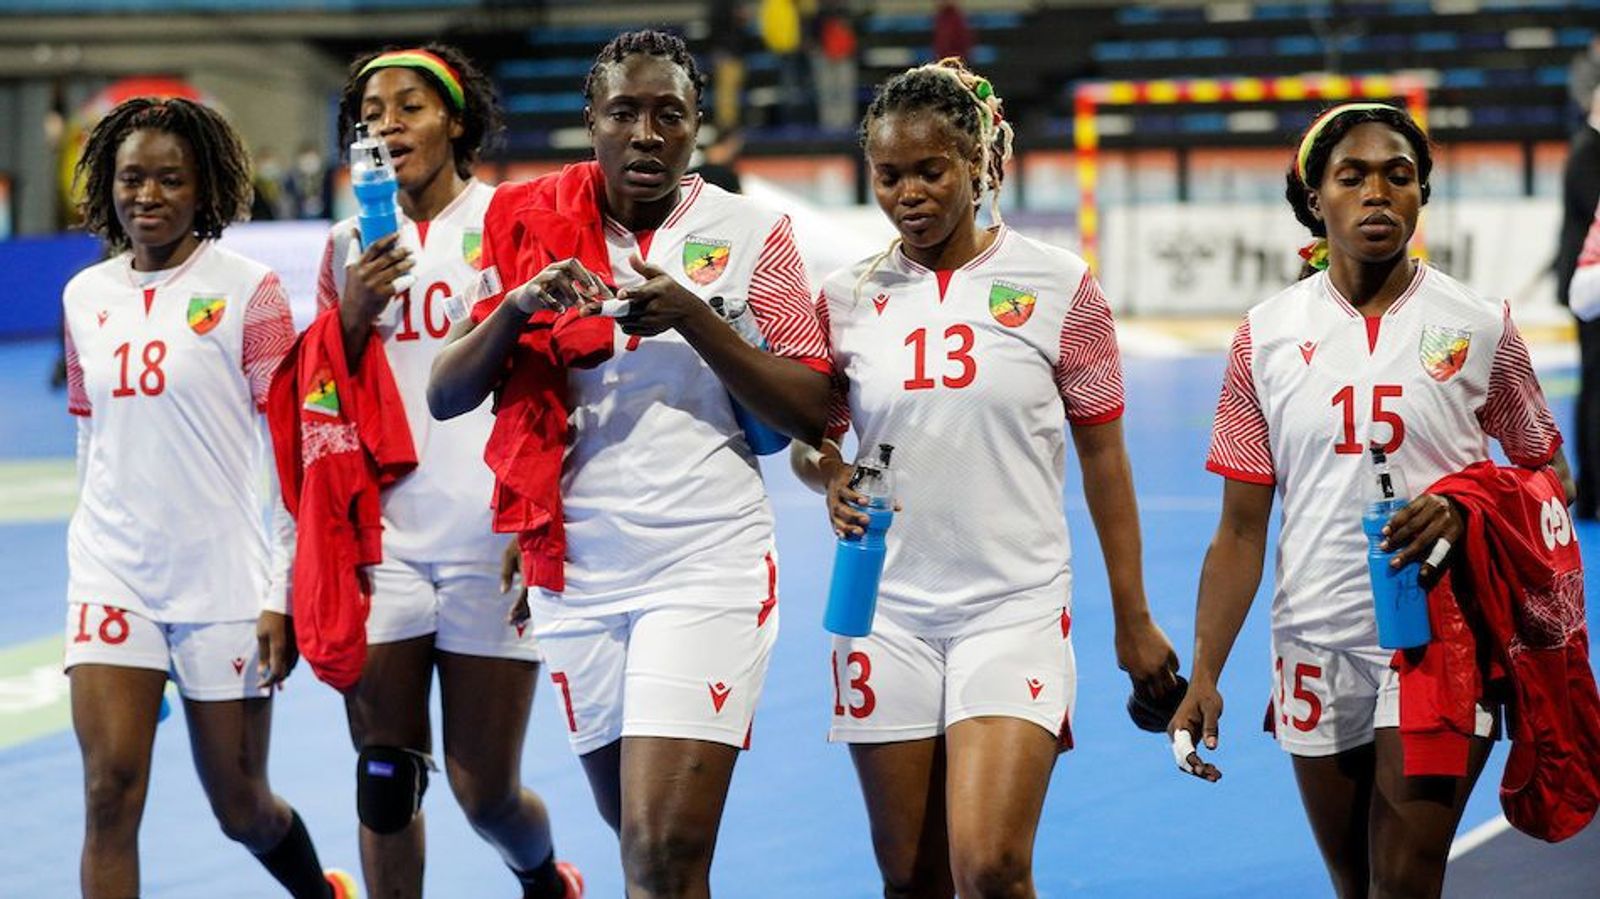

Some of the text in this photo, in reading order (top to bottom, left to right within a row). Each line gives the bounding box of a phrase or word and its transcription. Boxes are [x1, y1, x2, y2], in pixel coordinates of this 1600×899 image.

[112, 339, 168, 398] 18
[903, 323, 978, 391] 13
[1332, 385, 1405, 455] 15
[74, 603, 130, 645] 18
[832, 650, 876, 719] 13
[1276, 656, 1323, 733] 15
